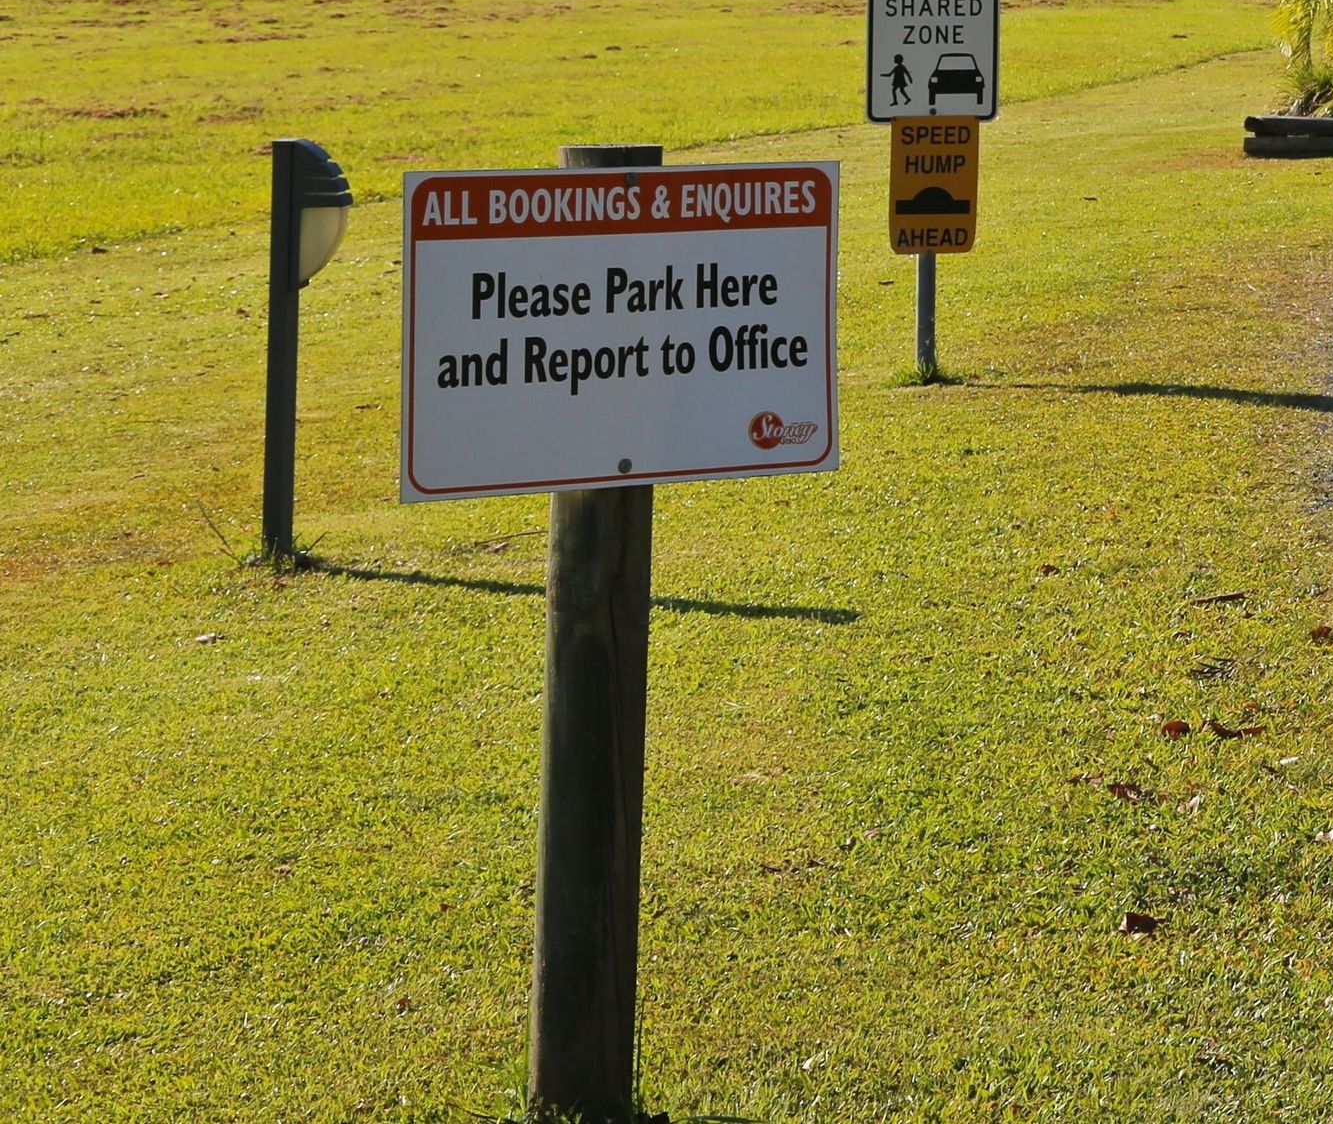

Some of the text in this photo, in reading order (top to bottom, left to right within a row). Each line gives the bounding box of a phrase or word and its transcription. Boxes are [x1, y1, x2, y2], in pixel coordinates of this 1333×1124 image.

[902, 25, 965, 44] ZONE
[900, 126, 971, 145] SPEED
[904, 154, 966, 174] HUMP
[422, 179, 817, 226] ALL BOOKINGS & ENQUIRES
[897, 228, 969, 248] AHEAD
[471, 262, 778, 320] Please Park Here
[437, 323, 808, 396] and Report to Office
